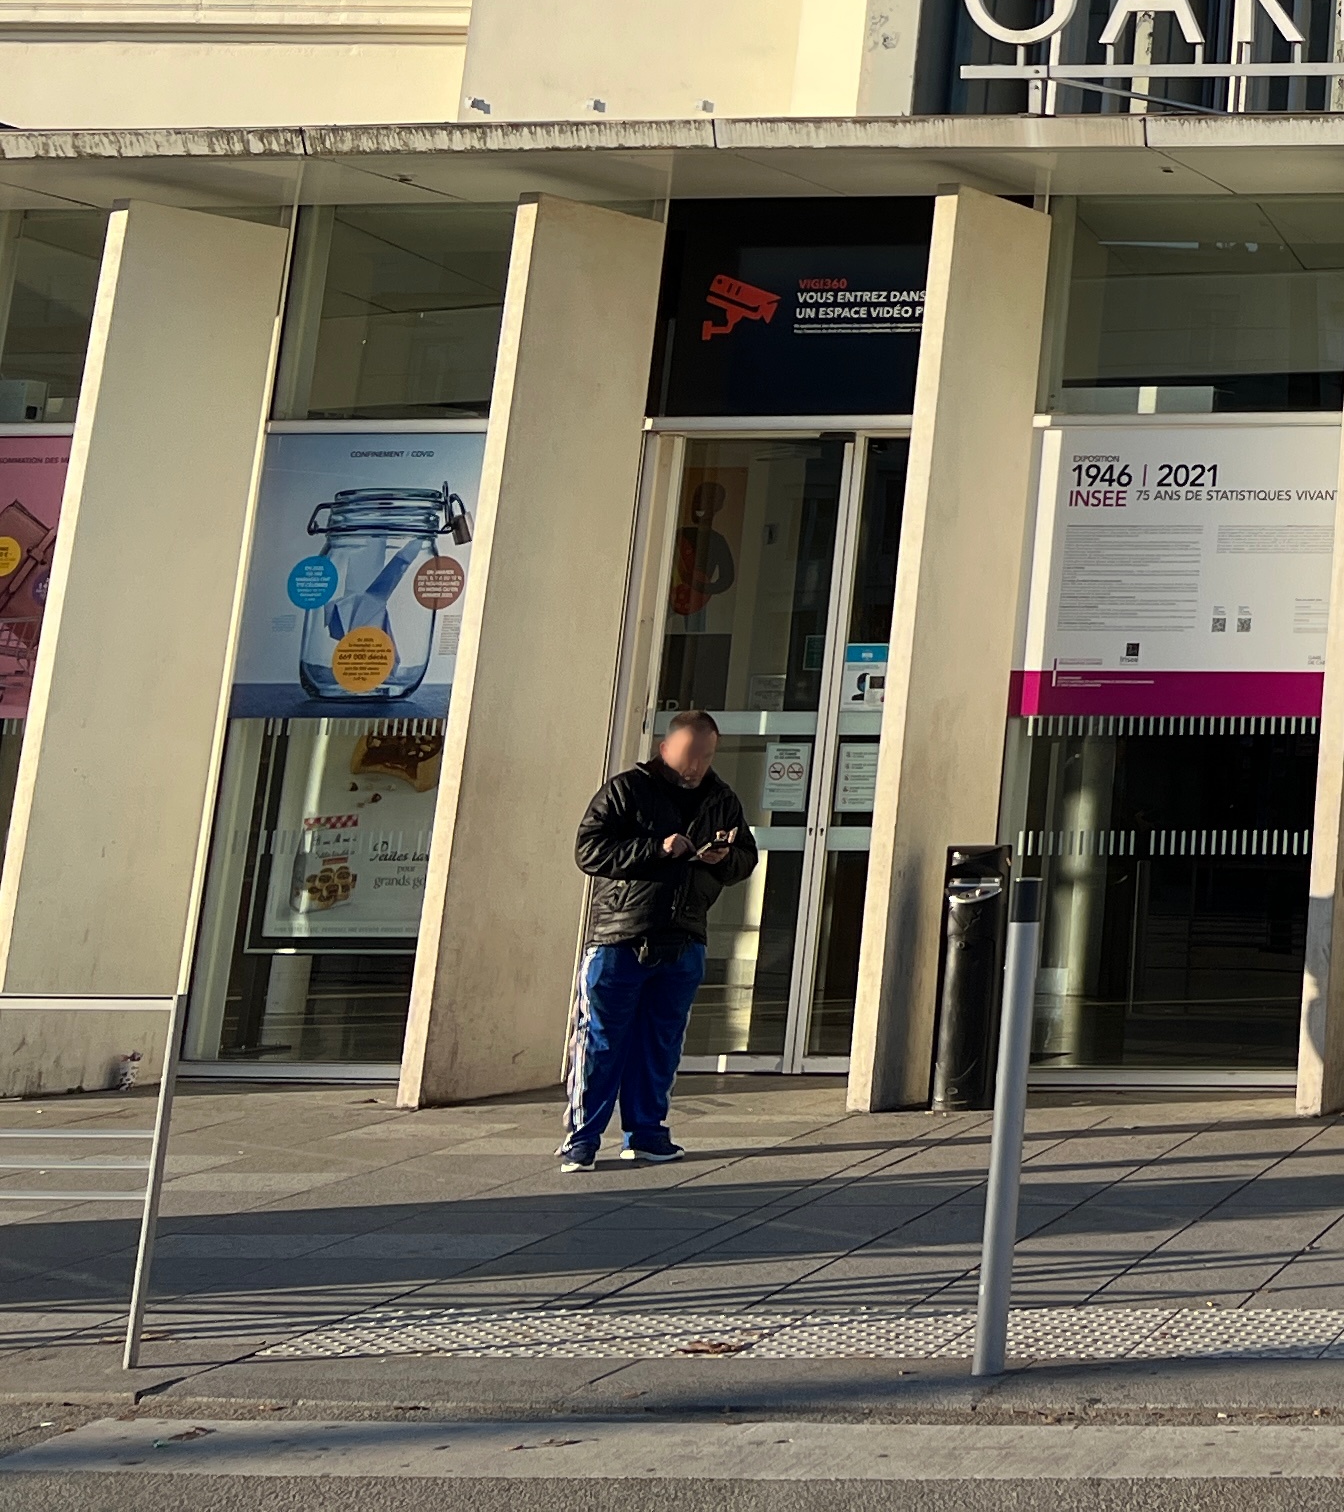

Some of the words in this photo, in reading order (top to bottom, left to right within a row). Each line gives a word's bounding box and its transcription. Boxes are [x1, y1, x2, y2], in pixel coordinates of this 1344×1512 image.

[799, 278, 848, 289] VIGI360
[797, 292, 834, 303] VOUS
[837, 291, 888, 302] ENTREZ
[890, 291, 926, 302] DANS
[796, 308, 815, 318] UN
[818, 307, 868, 318] ESPACE
[870, 304, 912, 318] VIDÉO
[1073, 455, 1120, 463] EXPOSITION
[1072, 464, 1133, 487] 1946
[1156, 464, 1218, 487] 2021
[1069, 490, 1128, 507] INSEE
[1136, 490, 1150, 501] 75
[1153, 490, 1181, 501] ANS
[1185, 490, 1202, 501] DE
[1206, 490, 1291, 501] STATISTIQUES
[1296, 490, 1338, 501] VIVAN
[373, 875, 410, 889] grands
[412, 877, 424, 889] go
